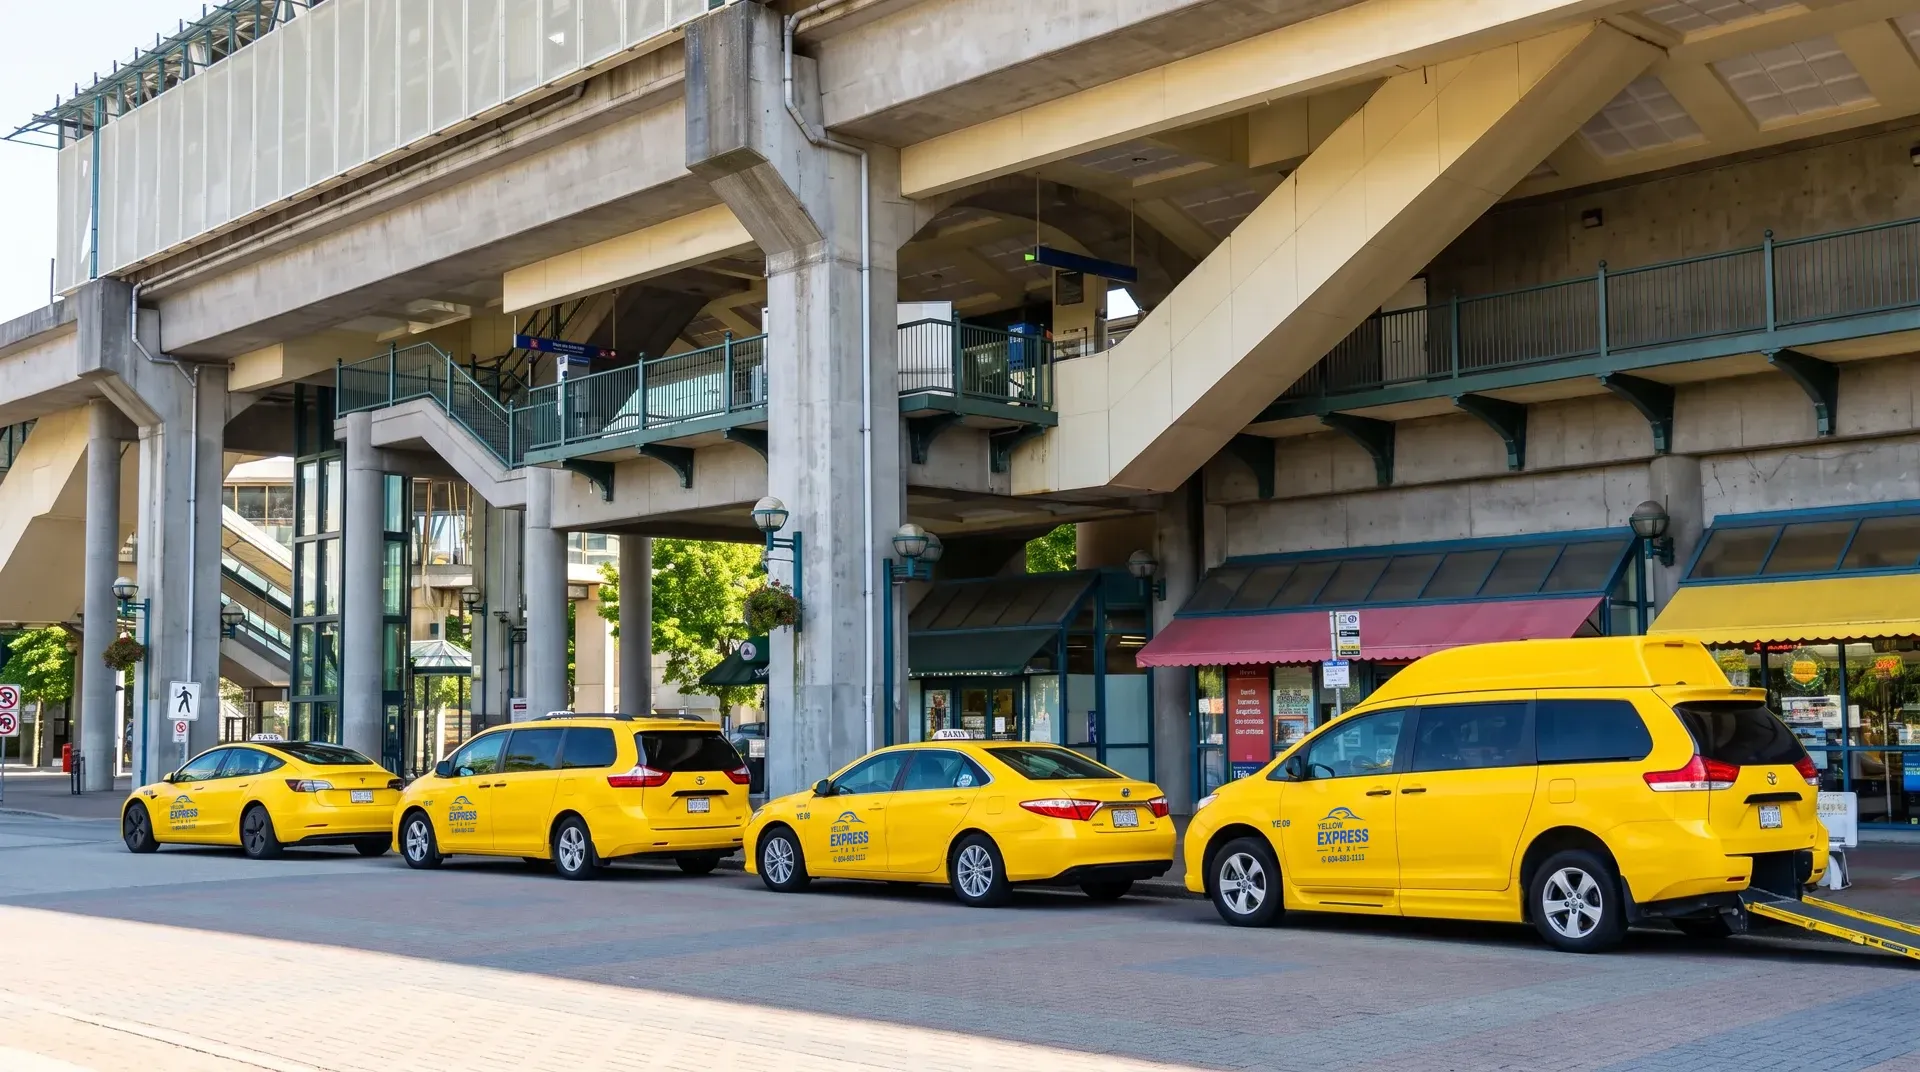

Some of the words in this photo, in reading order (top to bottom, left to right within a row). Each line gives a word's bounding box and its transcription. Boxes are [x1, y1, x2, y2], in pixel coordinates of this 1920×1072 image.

[170, 808, 198, 819] EXPRESS
[449, 810, 477, 821] EXPRESS
[830, 825, 850, 833] YELLOW
[1271, 820, 1281, 828] YE
[1282, 819, 1291, 827] 09
[1317, 822, 1344, 830] YELLOW
[830, 830, 869, 847] EXPRESS
[1317, 828, 1369, 846] EXPRESS
